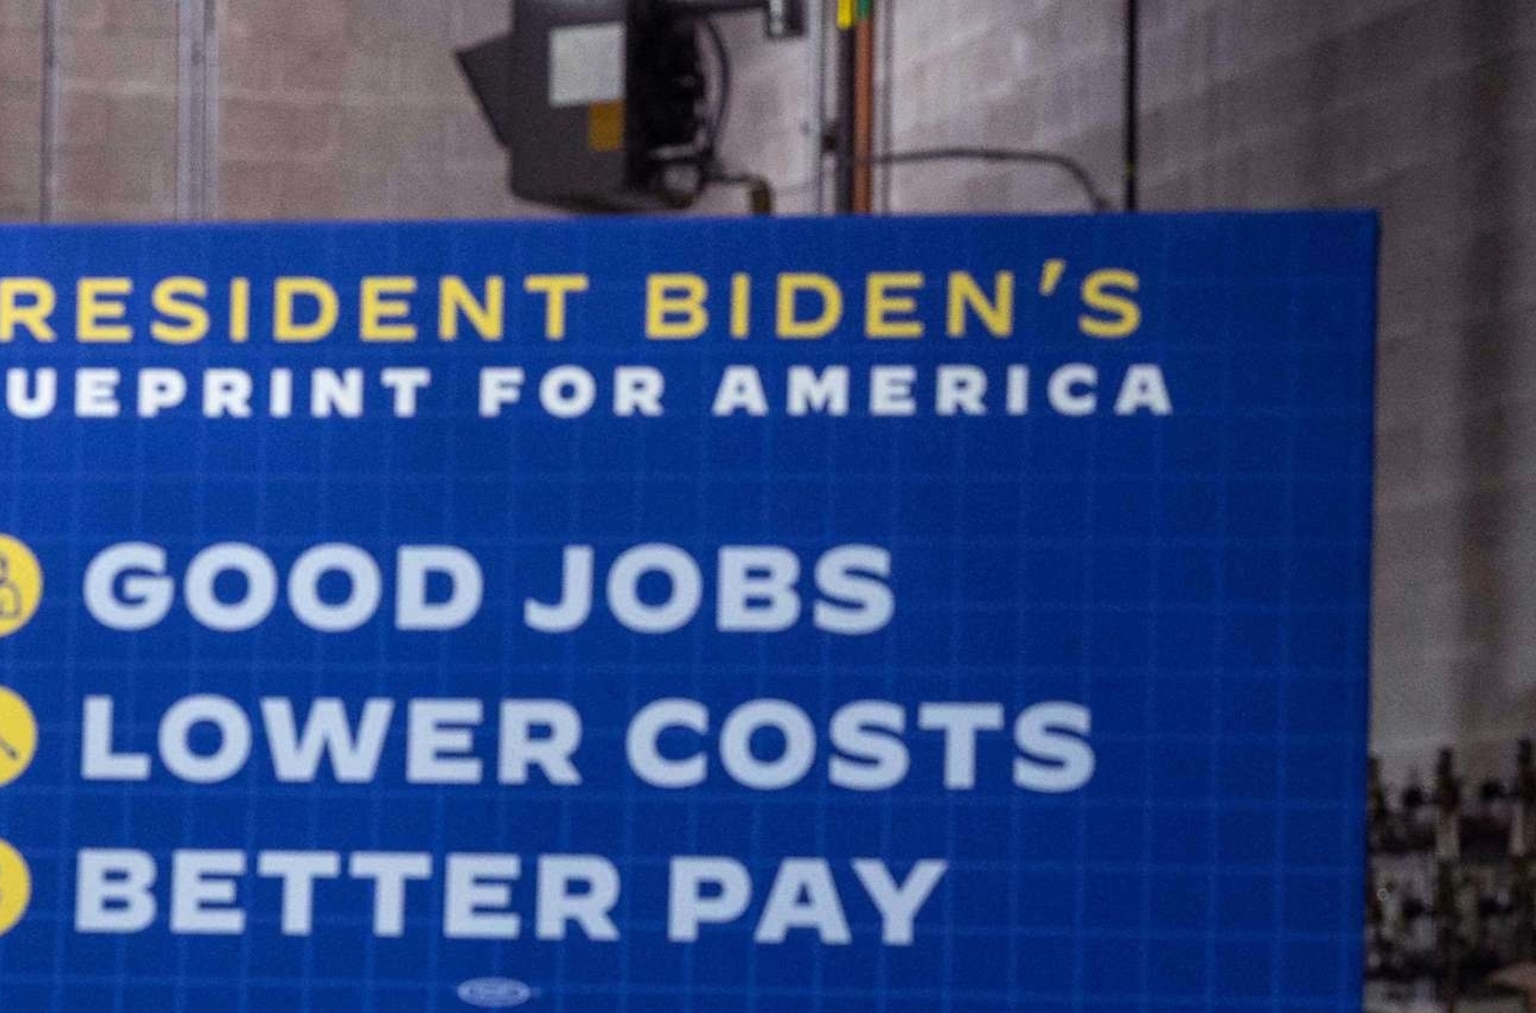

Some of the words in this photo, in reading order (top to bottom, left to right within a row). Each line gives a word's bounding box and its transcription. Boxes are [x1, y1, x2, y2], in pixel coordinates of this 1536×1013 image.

[645, 260, 1140, 339] BIDEN'S
[479, 365, 664, 418] FOR
[713, 364, 1171, 416] AMERICA
[84, 542, 483, 631] GOOD
[525, 543, 894, 634] JOBS
[82, 694, 581, 784] LOWER
[626, 699, 1094, 792] COSTS
[75, 848, 619, 940] BETTER
[668, 856, 947, 945] PAY
